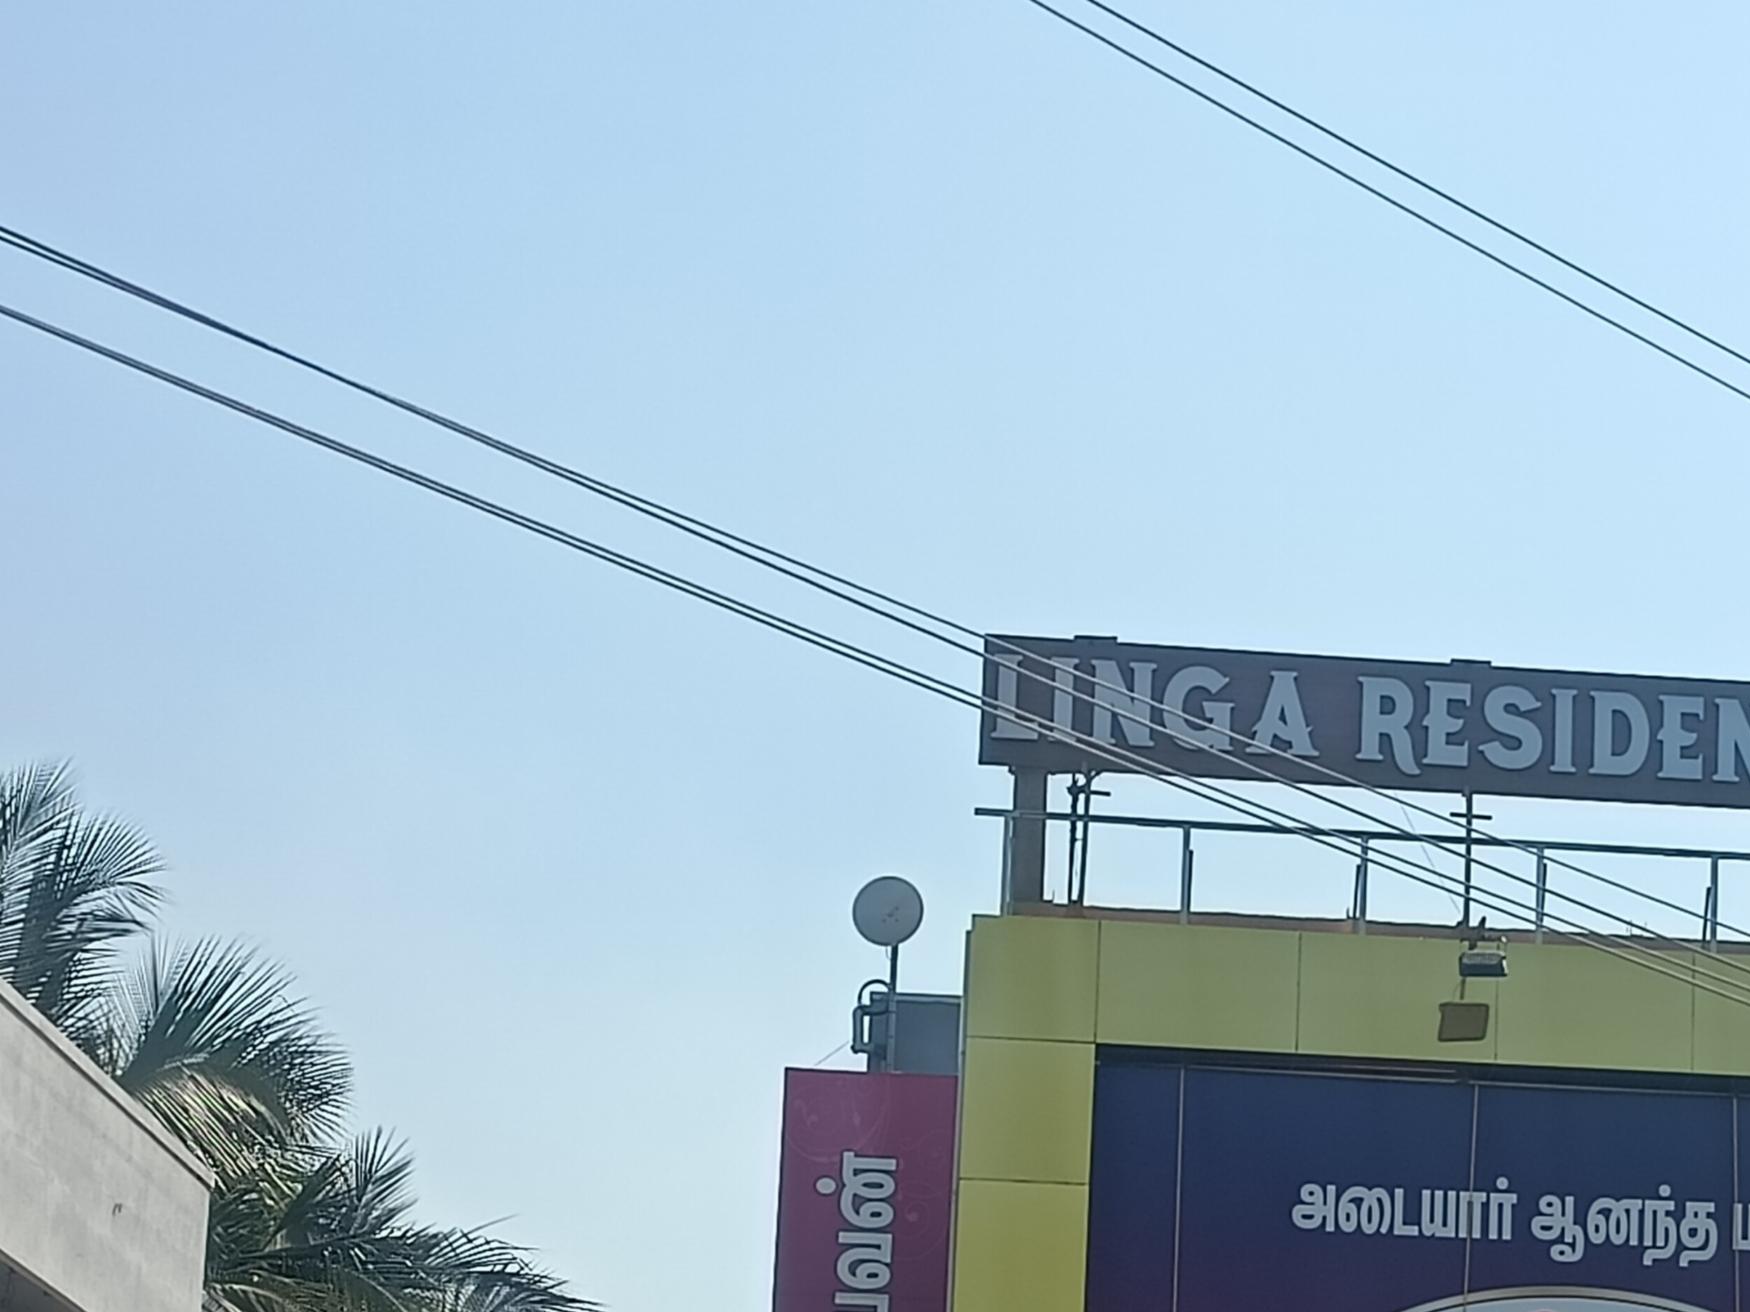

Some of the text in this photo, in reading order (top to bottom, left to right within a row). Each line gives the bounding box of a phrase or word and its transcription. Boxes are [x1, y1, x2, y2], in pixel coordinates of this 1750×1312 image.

[989, 652, 1320, 758] LINGA
[1291, 1177, 1517, 1240] அடையார்
[1530, 1185, 1718, 1266] ஆனந்த
